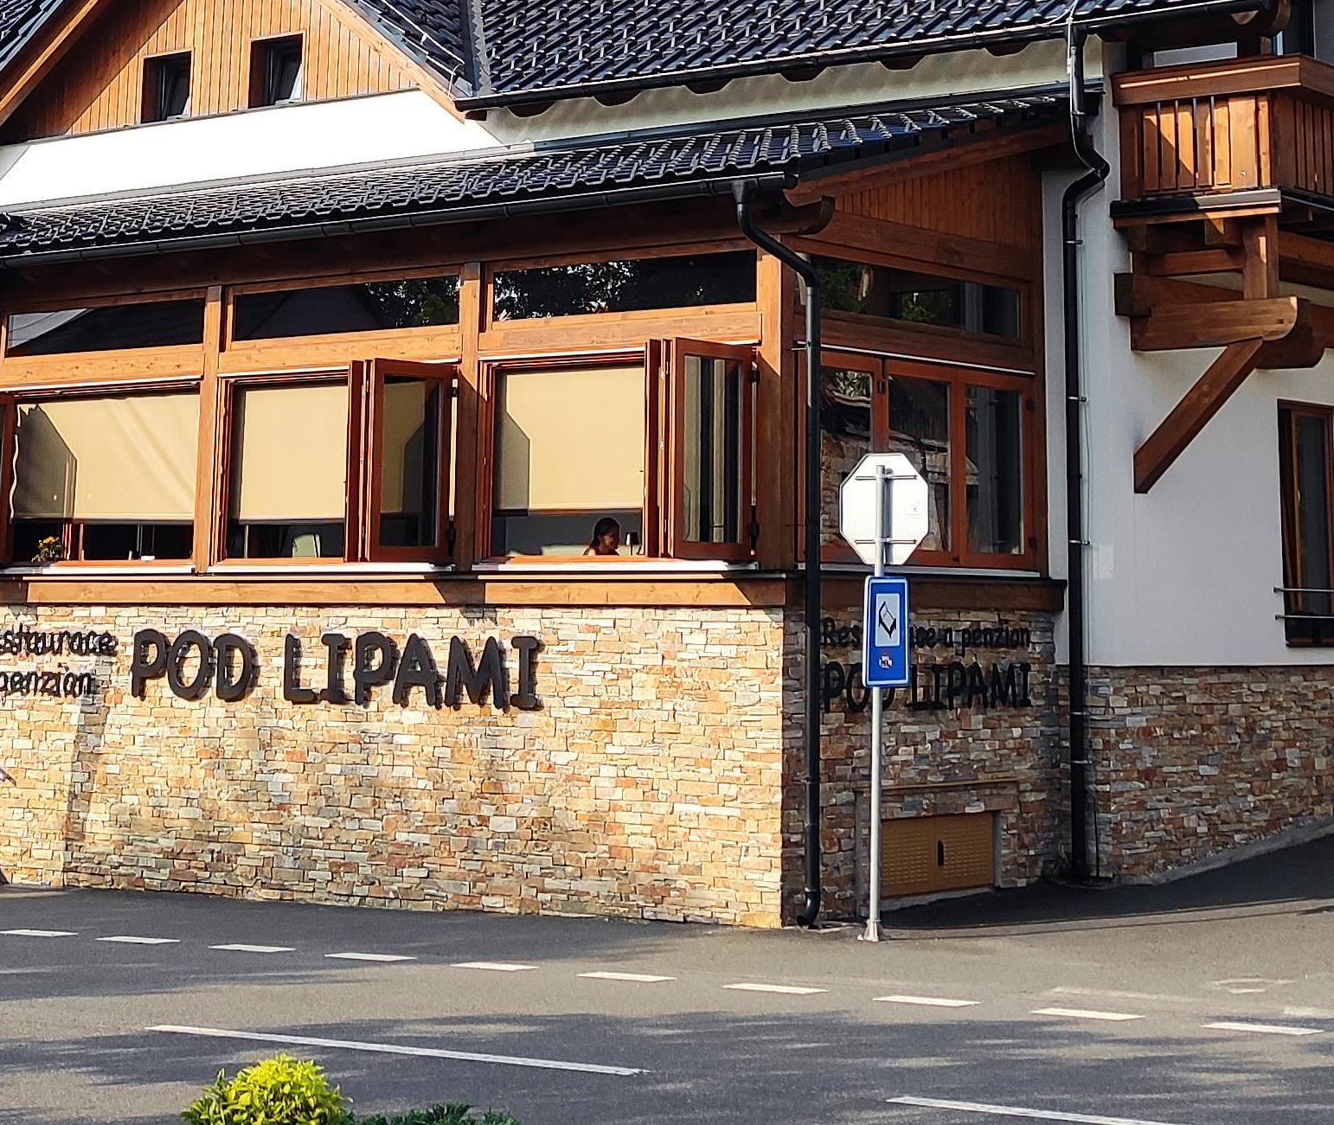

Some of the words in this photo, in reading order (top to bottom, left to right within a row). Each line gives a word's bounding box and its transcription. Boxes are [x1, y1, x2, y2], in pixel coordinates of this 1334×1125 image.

[960, 626, 1031, 657] penzion
[130, 628, 261, 702] POD
[283, 631, 546, 713] LIPAMI
[907, 661, 1032, 711] LIPAMI
